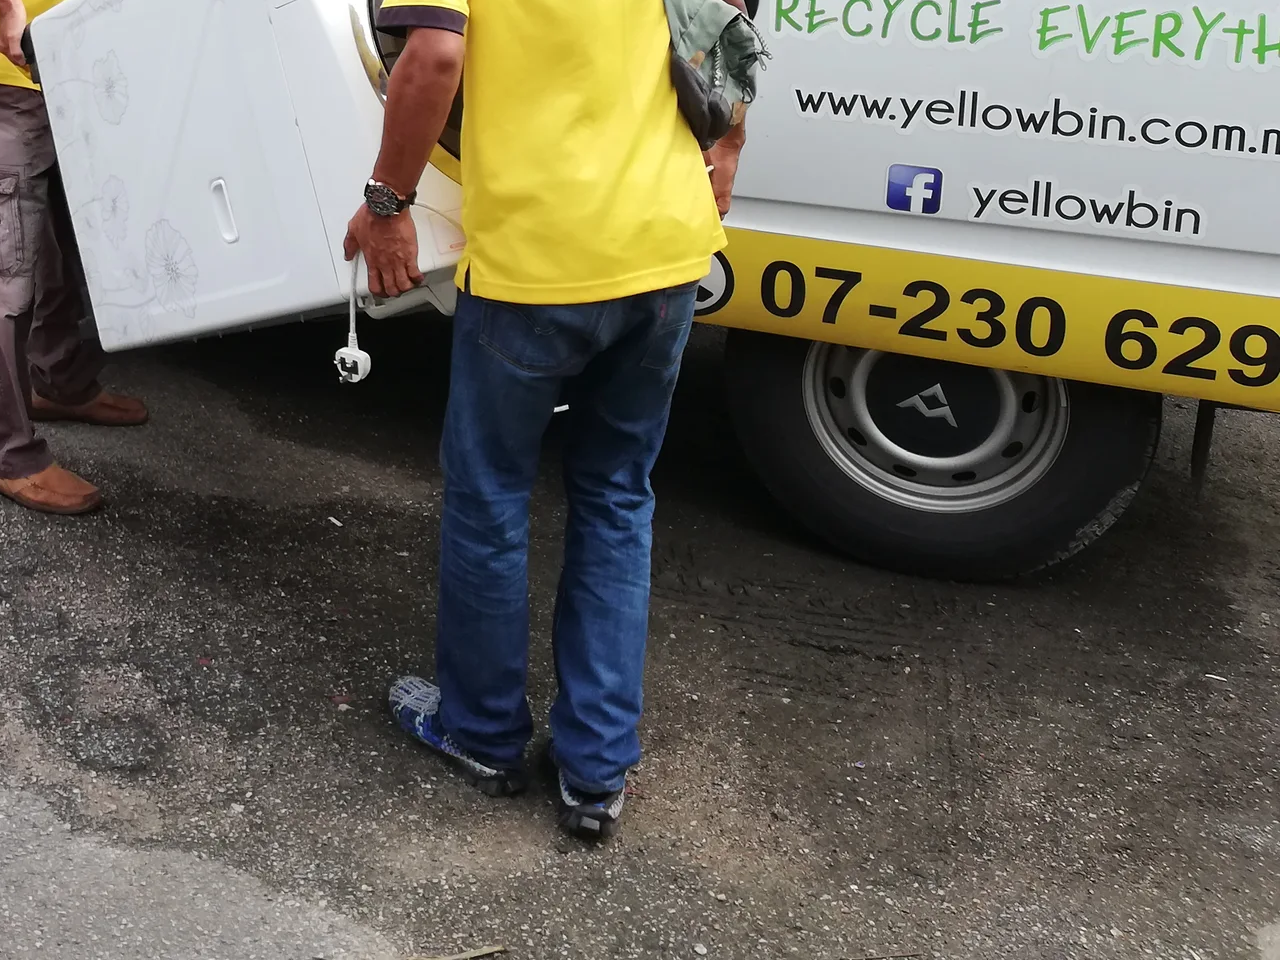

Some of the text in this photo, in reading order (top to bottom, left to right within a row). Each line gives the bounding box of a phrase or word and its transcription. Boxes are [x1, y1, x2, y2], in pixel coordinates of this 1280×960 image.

[972, 180, 1202, 235] yellowbin
[759, 260, 1280, 387] 07-230 629
